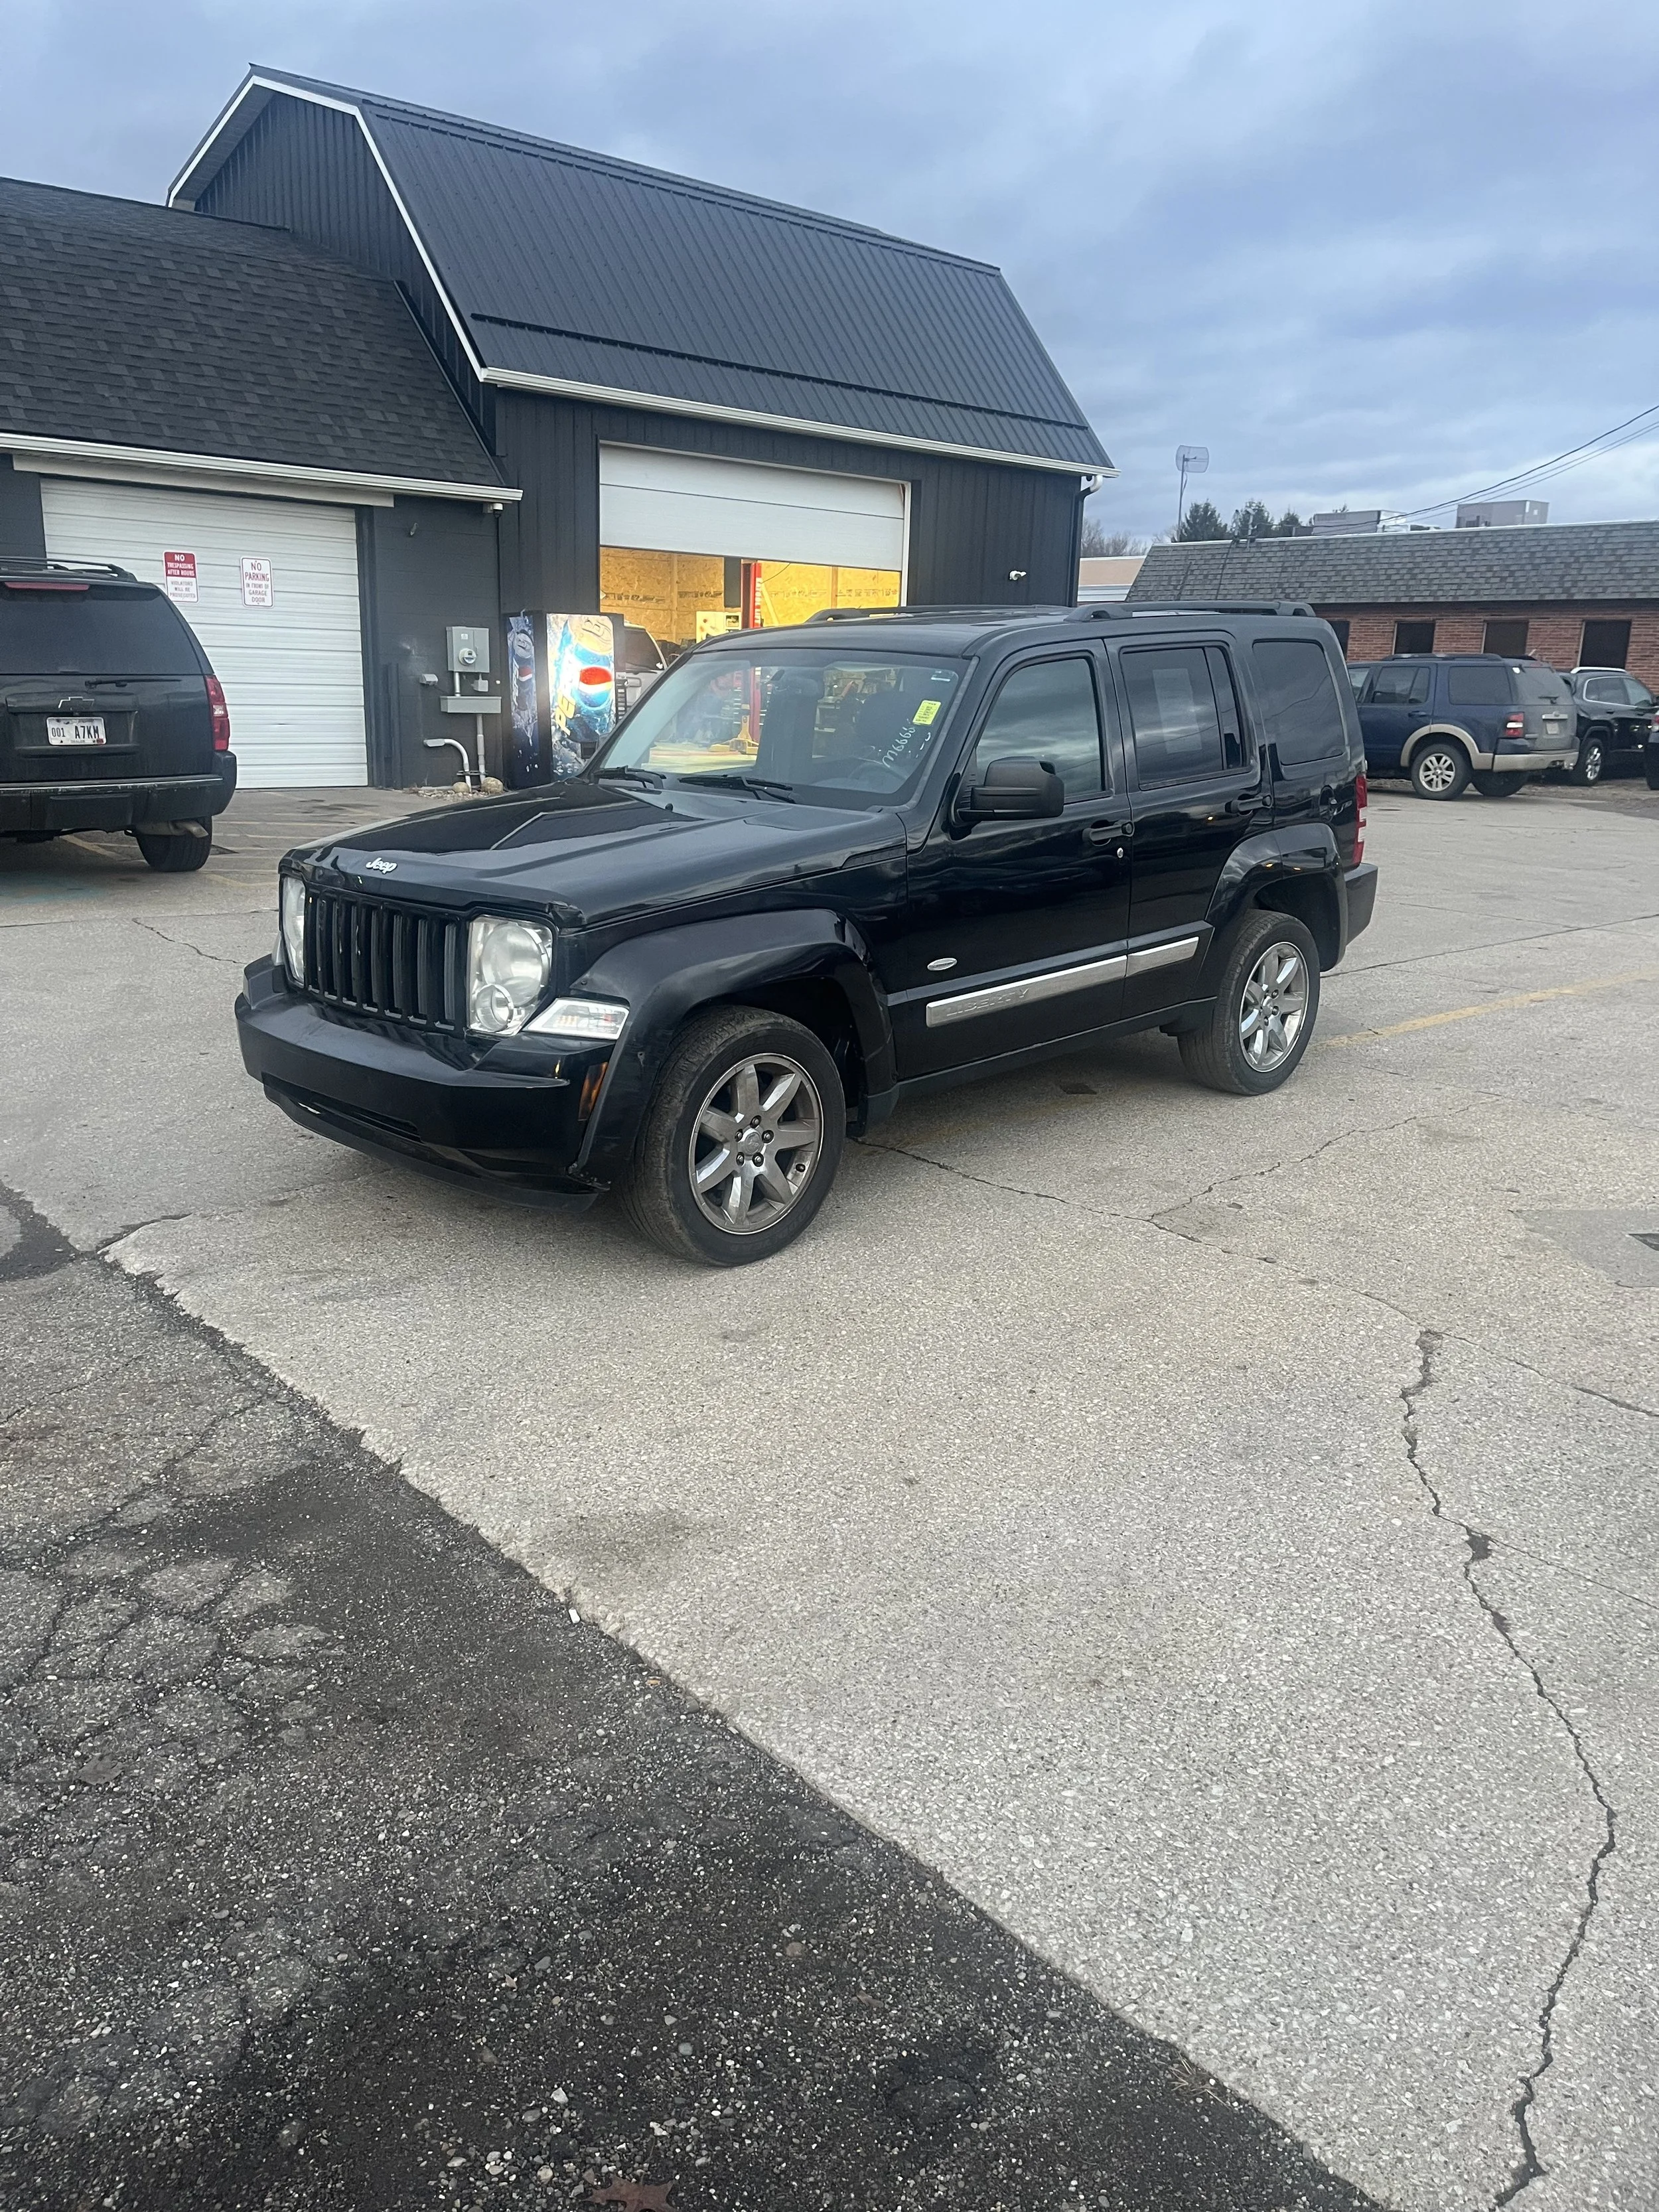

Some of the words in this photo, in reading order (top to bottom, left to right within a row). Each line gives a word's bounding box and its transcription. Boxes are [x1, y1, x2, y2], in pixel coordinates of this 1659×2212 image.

[252, 562, 261, 571] NO
[245, 572, 269, 581] PARKING
[52, 727, 66, 737] 001
[366, 857, 397, 874] Jeep
